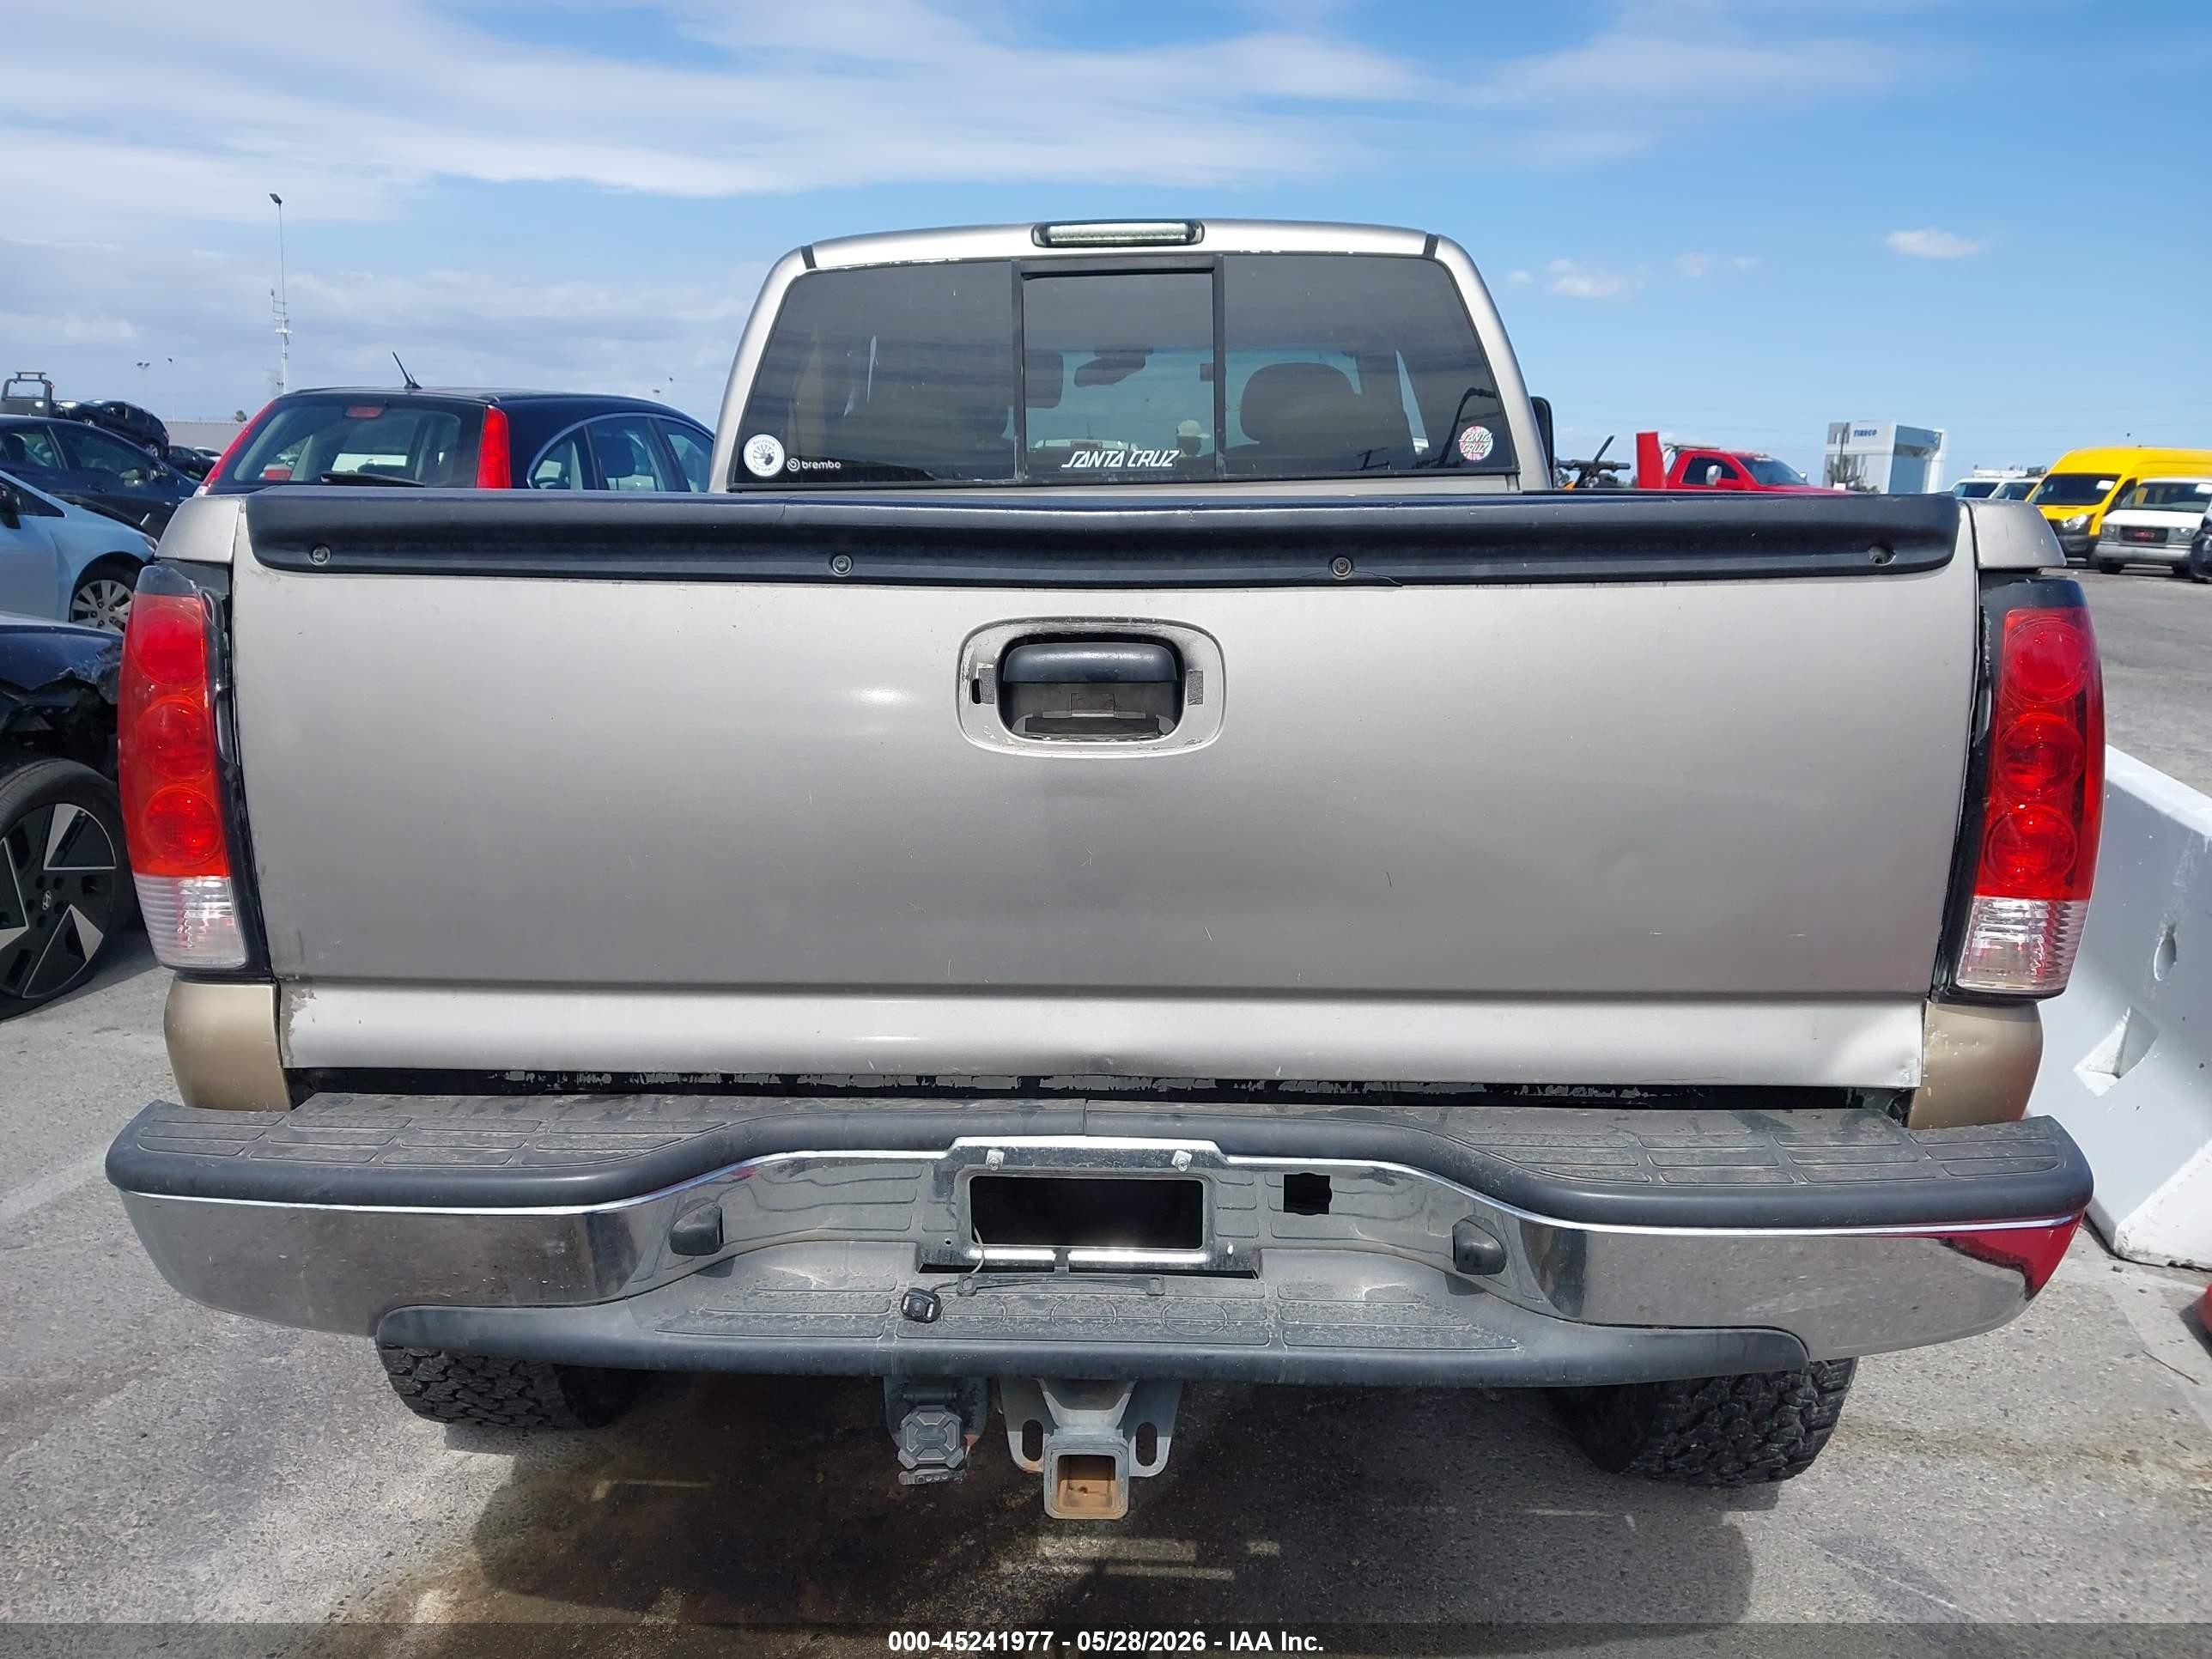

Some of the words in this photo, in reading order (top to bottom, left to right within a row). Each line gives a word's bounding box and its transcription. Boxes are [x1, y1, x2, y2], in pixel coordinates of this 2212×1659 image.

[1458, 431, 1492, 442] SANTA
[1461, 442, 1490, 453] CRUZ
[1060, 449, 1126, 468] SANTA
[1127, 448, 1180, 468] CRUZ
[801, 459, 842, 469] brembo
